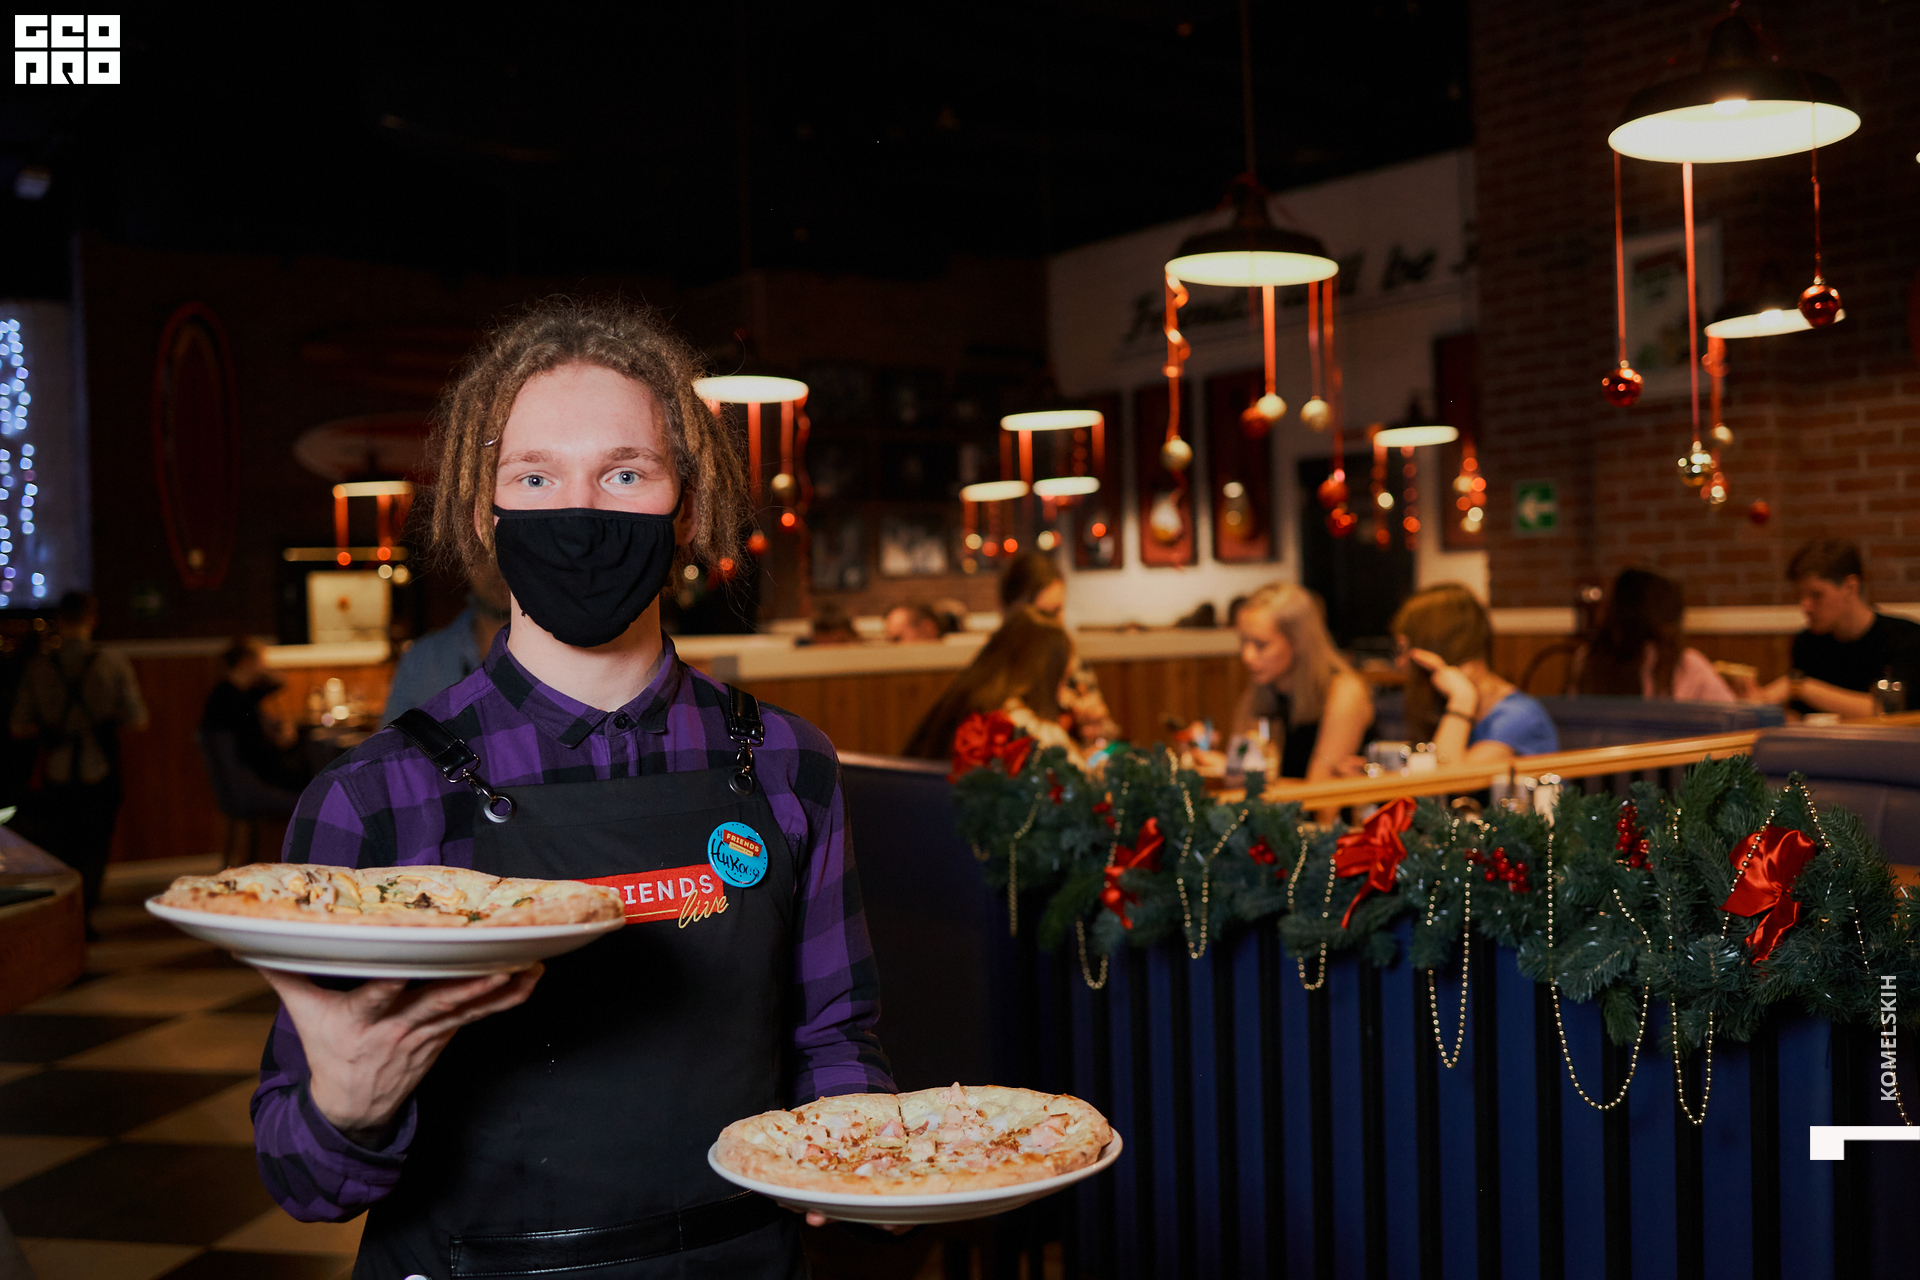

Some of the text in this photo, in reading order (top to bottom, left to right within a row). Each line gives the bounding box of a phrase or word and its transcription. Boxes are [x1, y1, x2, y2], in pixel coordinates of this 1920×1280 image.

[726, 833, 760, 852] FRIENDS
[609, 875, 714, 905] IENDS
[678, 889, 729, 929] live
